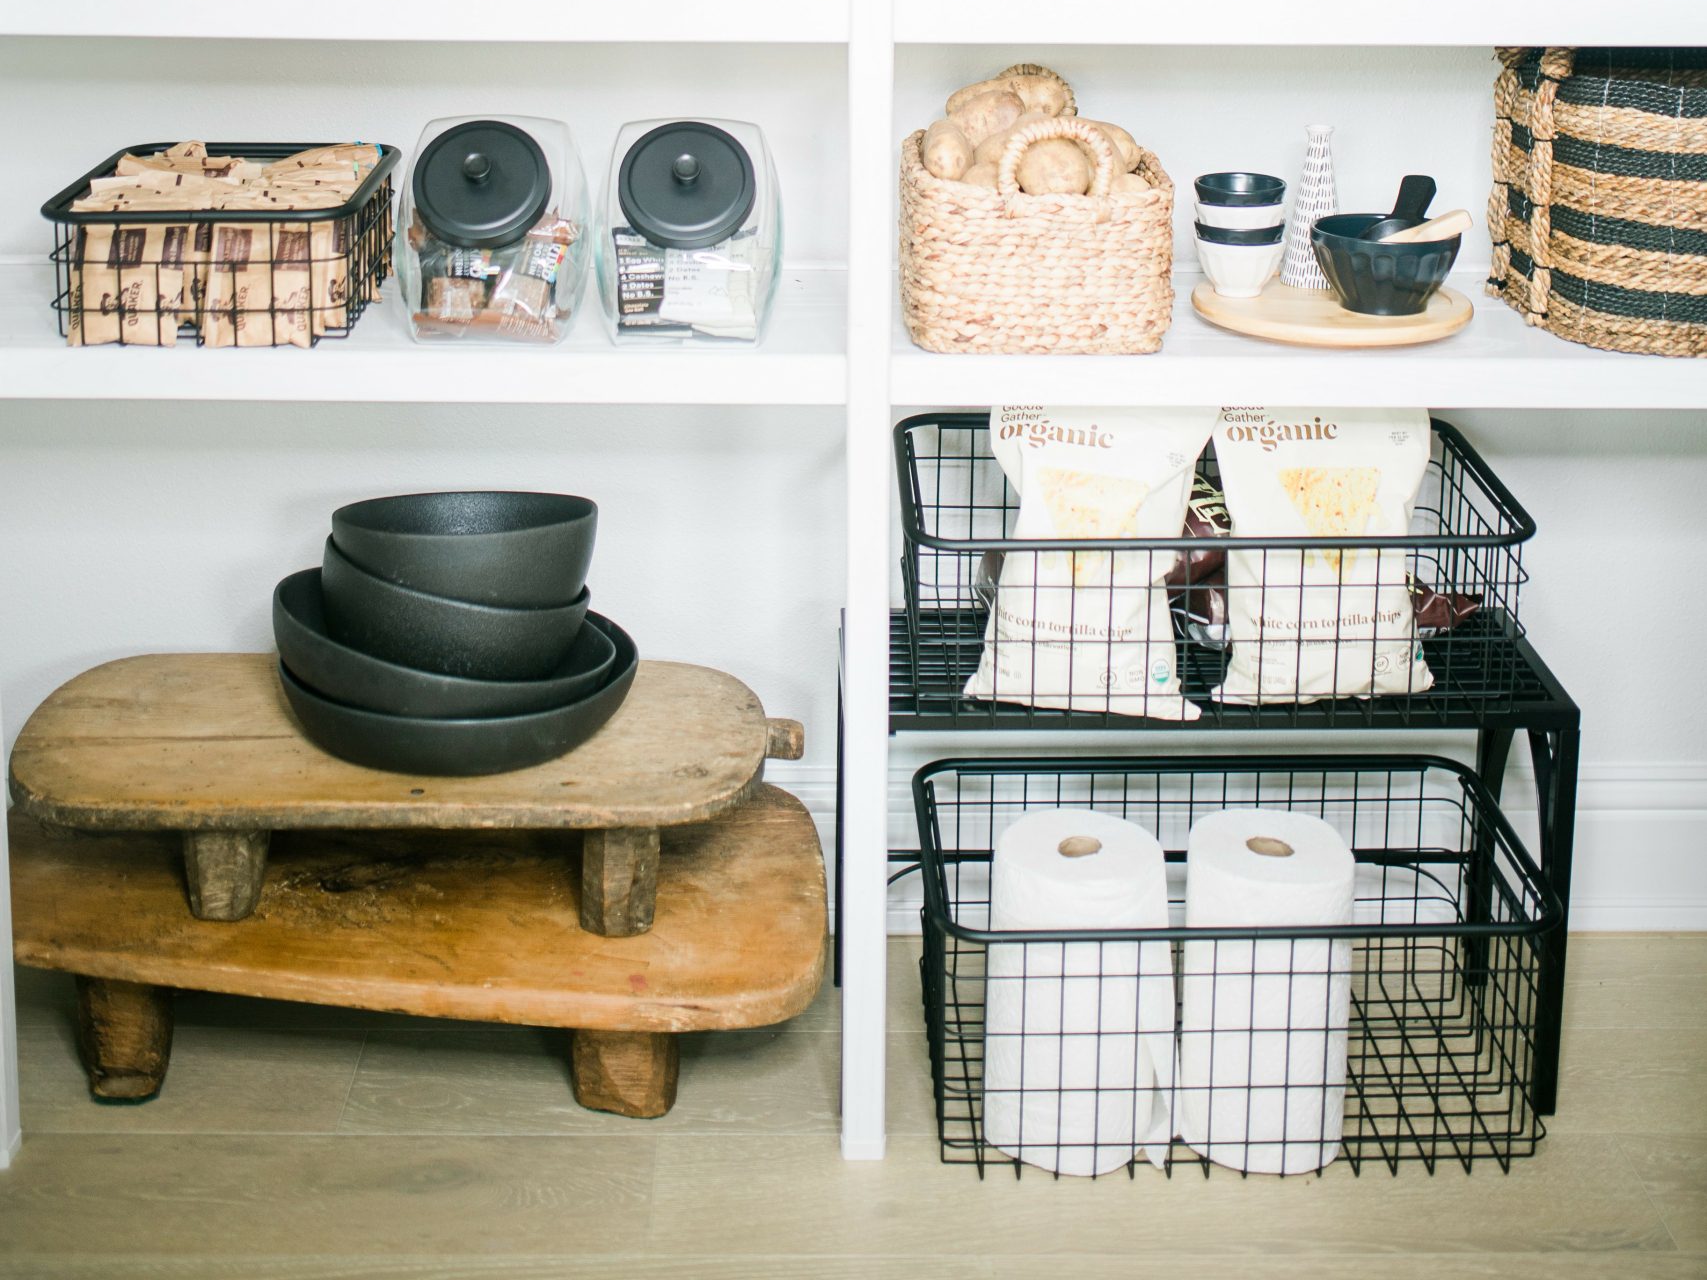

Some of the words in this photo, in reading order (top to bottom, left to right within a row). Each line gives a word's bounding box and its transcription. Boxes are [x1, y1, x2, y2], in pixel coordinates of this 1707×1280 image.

[1000, 412, 1040, 423] Gather
[1223, 411, 1265, 423] Gather
[999, 419, 1115, 450] organic
[1226, 416, 1338, 453] organic
[997, 604, 1014, 624] hite
